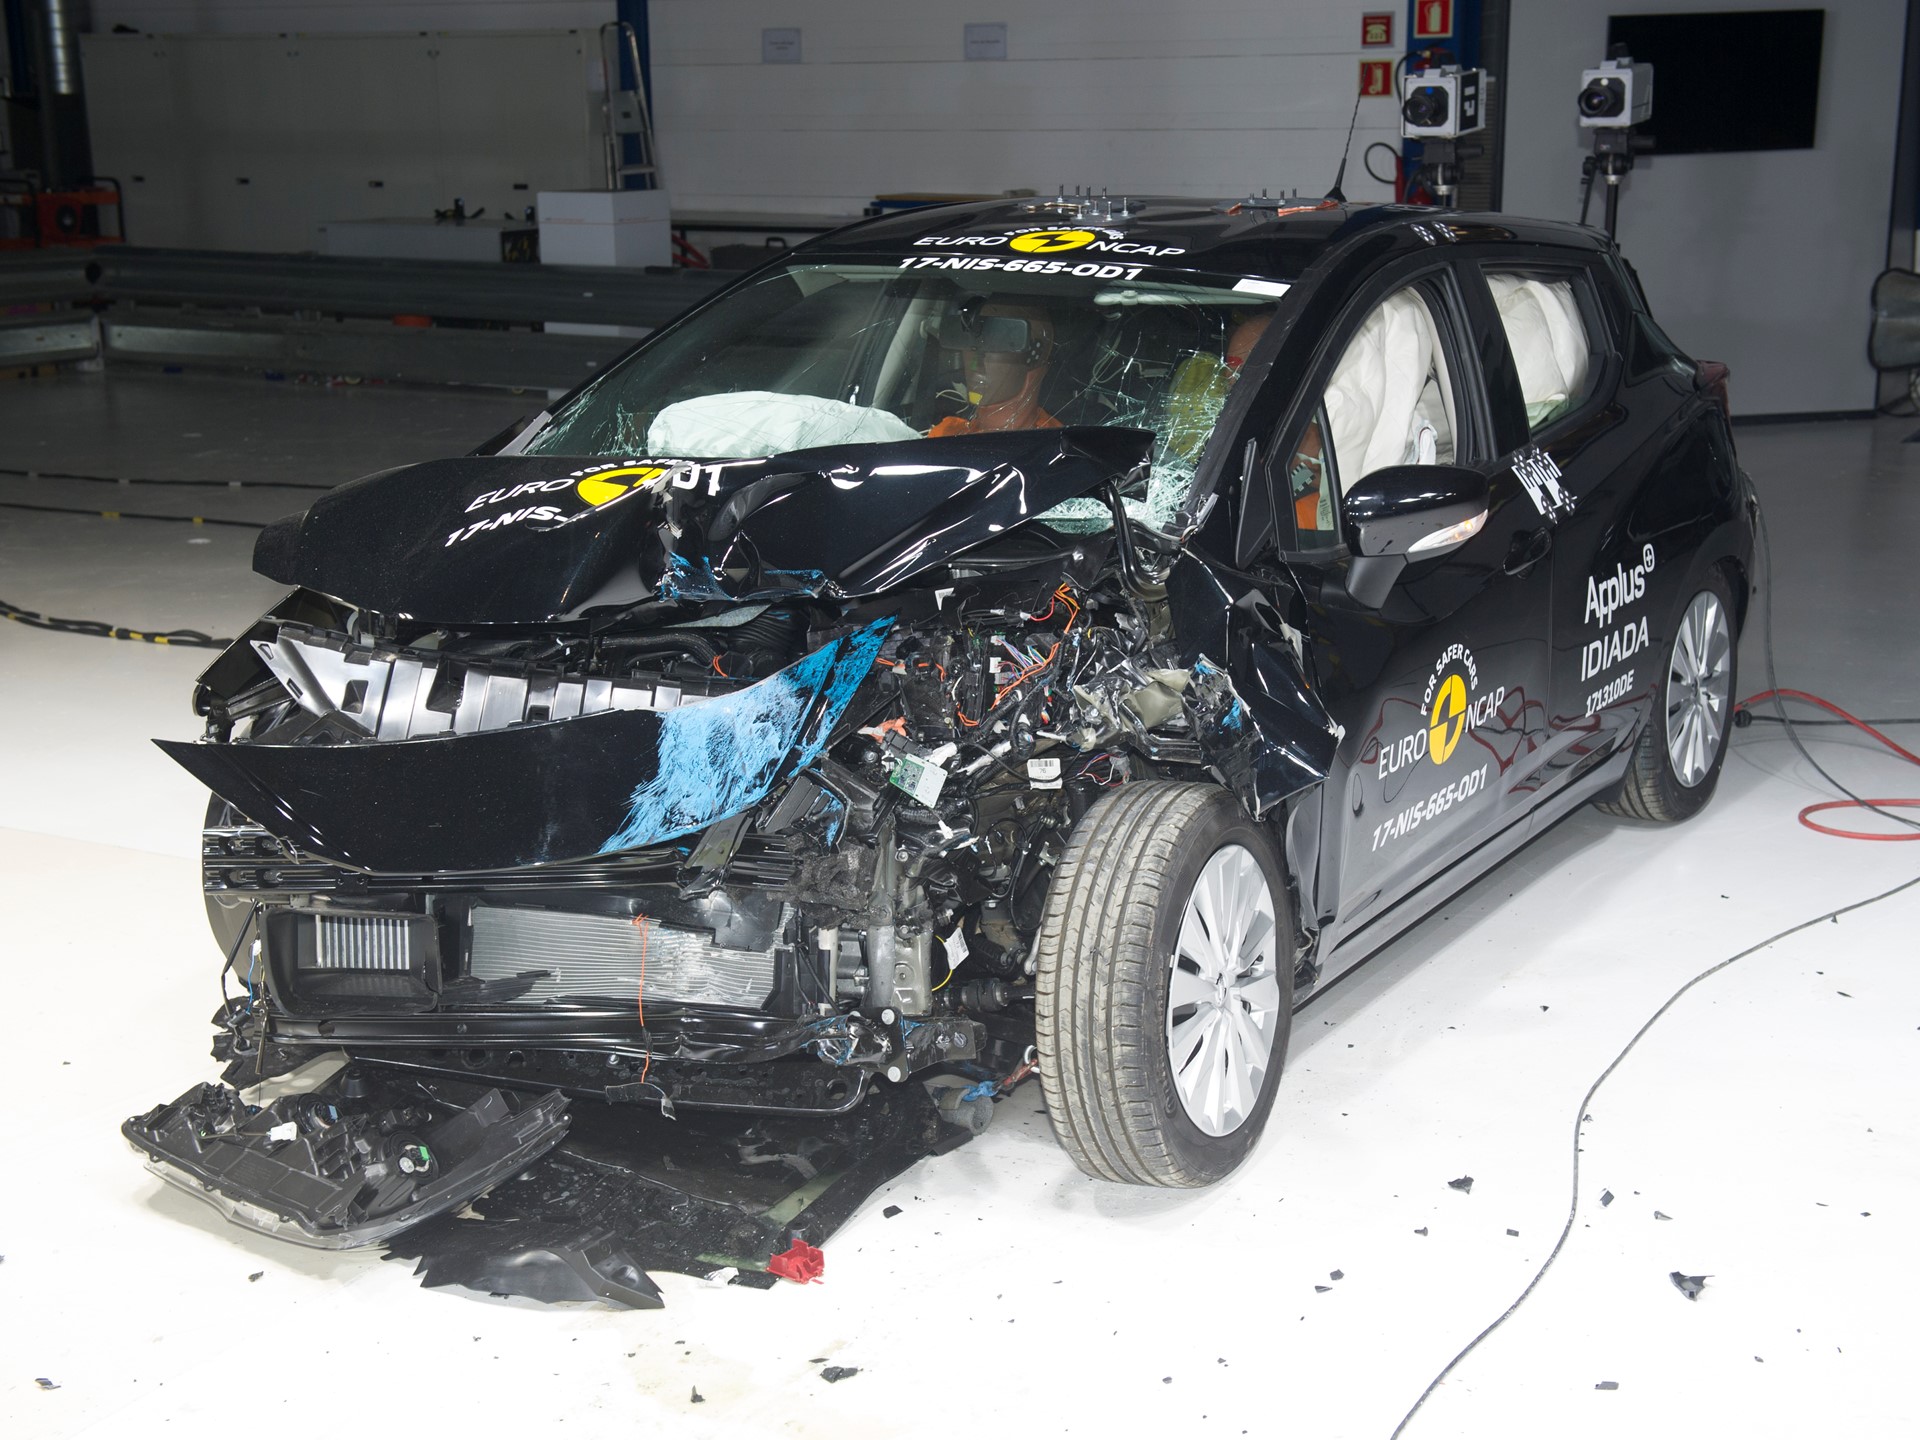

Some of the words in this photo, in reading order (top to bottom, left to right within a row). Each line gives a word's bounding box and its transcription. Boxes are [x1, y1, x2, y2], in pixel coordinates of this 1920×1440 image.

[913, 234, 1008, 248] EURO
[1085, 240, 1187, 257] NCAP
[464, 478, 575, 513] EURO
[570, 463, 618, 477] FOR
[1584, 562, 1645, 629] Applus
[1581, 615, 1649, 682] IDIADA
[1420, 673, 1437, 716] FOR
[1436, 643, 1464, 676] SAFER
[1463, 649, 1478, 691] CARS
[1585, 669, 1635, 718] 171310DE
[1378, 728, 1427, 780] EURO
[1465, 686, 1505, 733] NCAP
